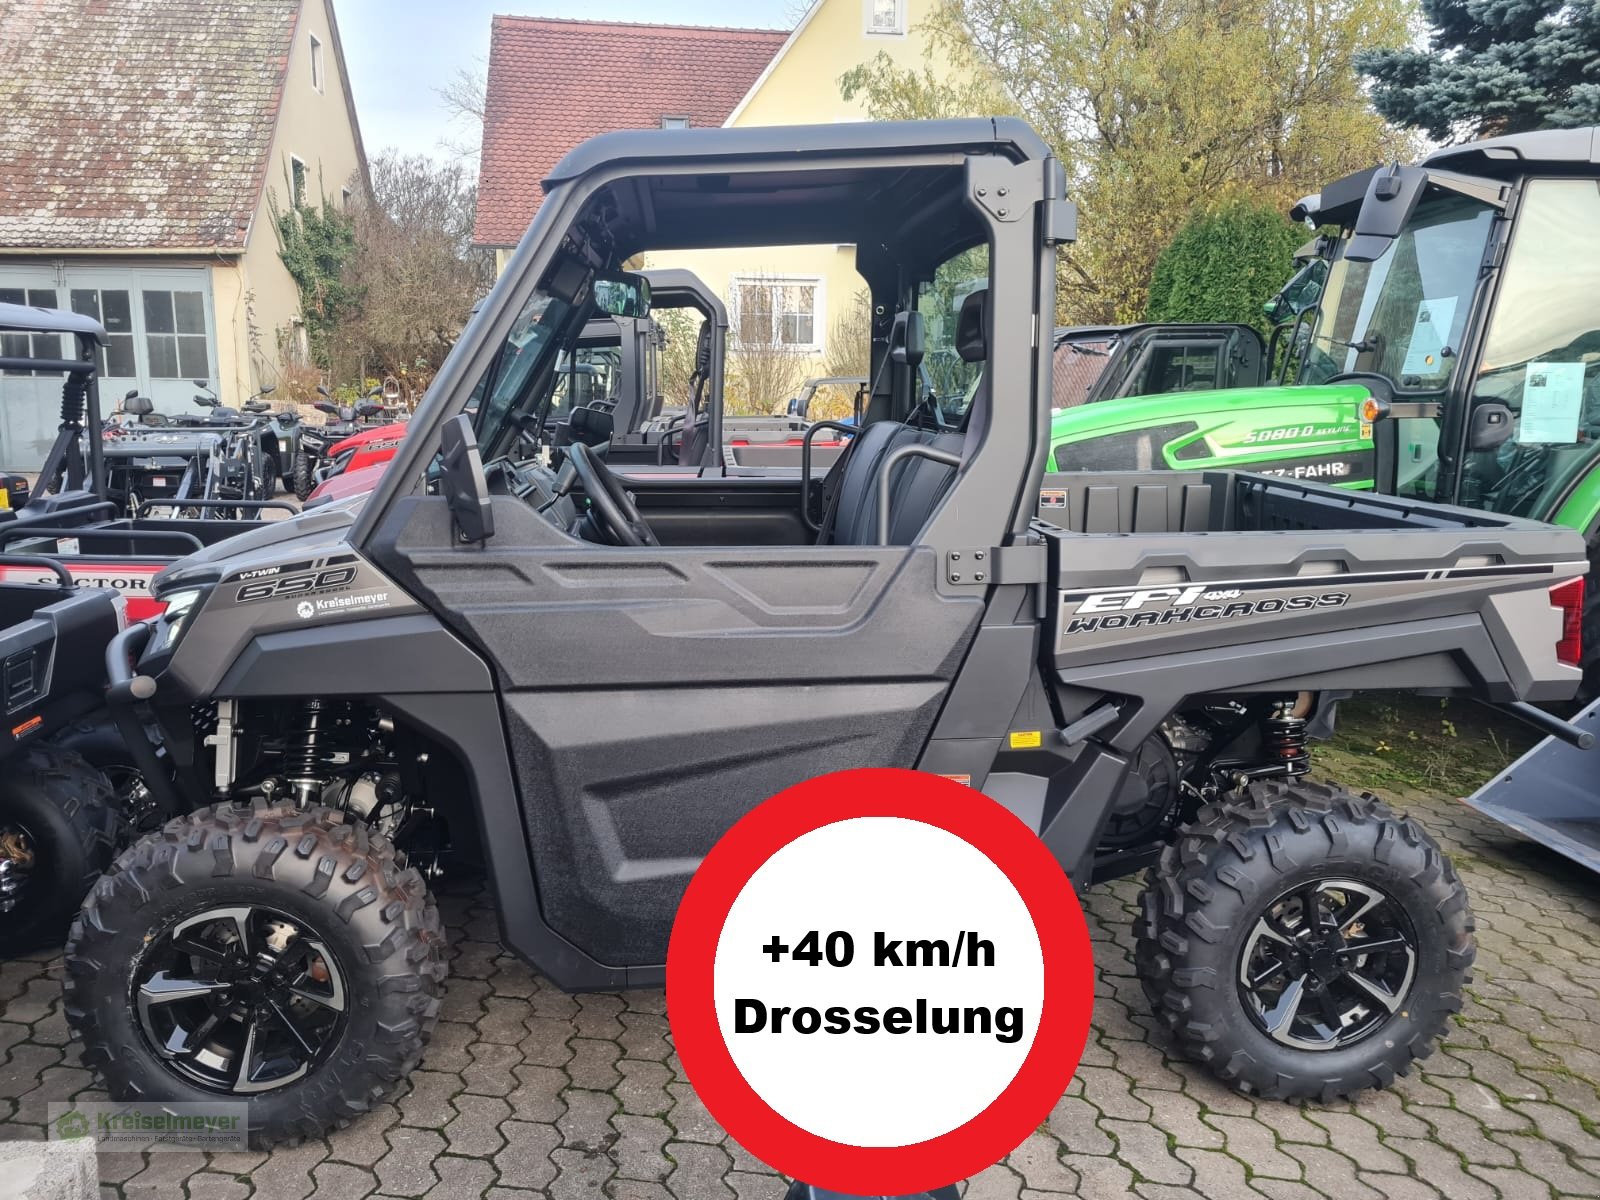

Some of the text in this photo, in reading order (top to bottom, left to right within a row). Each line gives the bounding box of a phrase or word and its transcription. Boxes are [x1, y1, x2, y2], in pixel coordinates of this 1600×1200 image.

[1243, 427, 1297, 444] 5080
[239, 566, 281, 580] V-TWIN
[37, 578, 148, 590] SCTOR
[235, 565, 358, 603] 650
[316, 592, 389, 610] Kreiselmeyer
[1074, 585, 1208, 614] EFI
[1063, 591, 1352, 635] WORKCROSS
